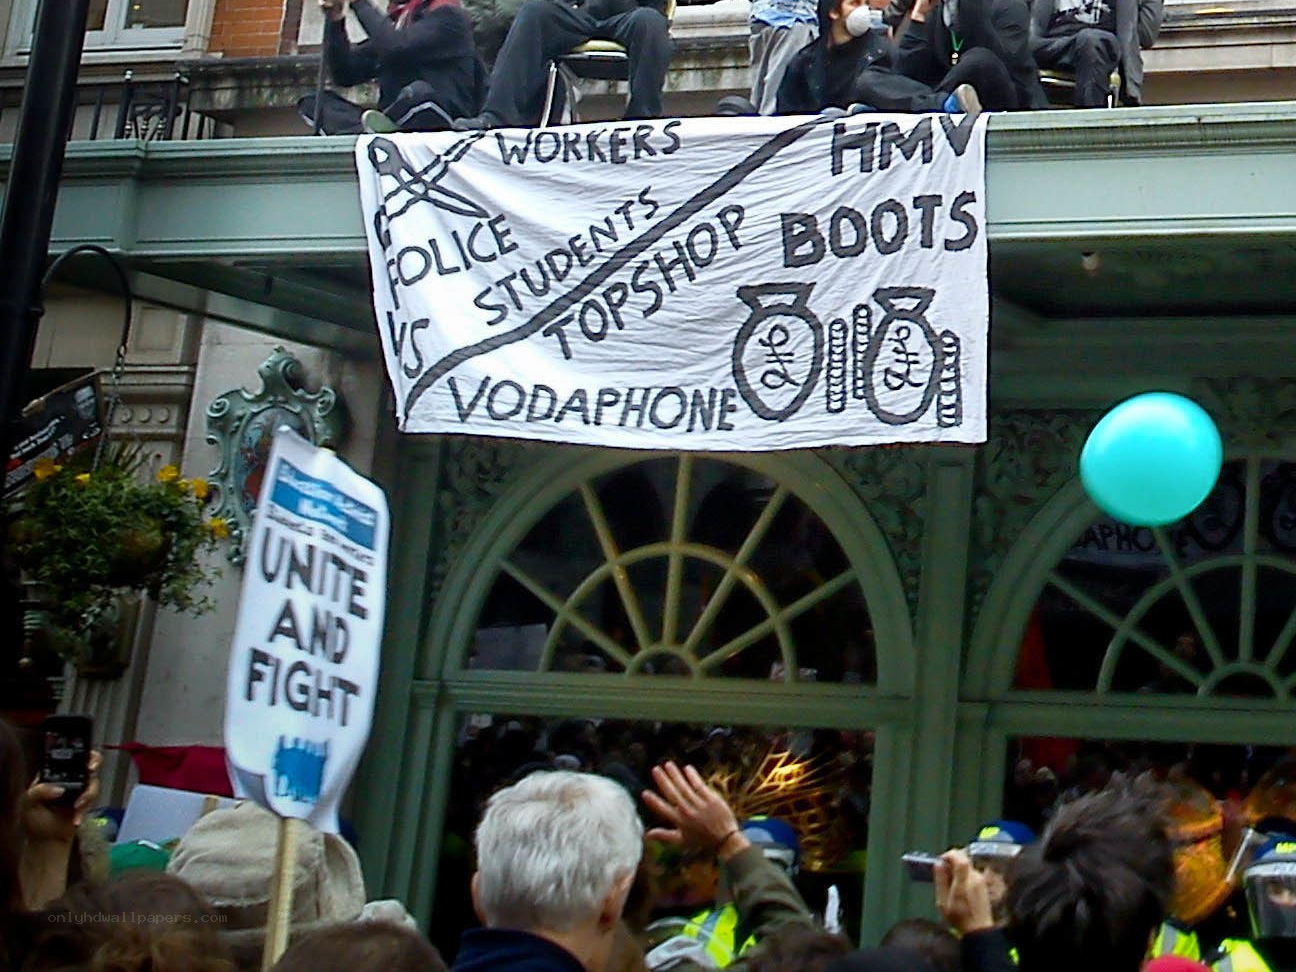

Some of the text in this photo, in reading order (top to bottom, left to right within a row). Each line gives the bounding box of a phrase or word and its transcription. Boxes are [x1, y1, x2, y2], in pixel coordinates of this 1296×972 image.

[495, 121, 681, 165] WORKERS
[831, 114, 981, 177] HMV
[473, 186, 660, 326] STUDENTS
[781, 190, 979, 268] BOOTS
[543, 204, 745, 360] TOPSHOP
[387, 311, 430, 379] VS
[446, 375, 738, 432] VODAPHONE
[262, 527, 370, 620] UNITE
[267, 598, 350, 665] AND
[246, 647, 361, 727] FIGHT
